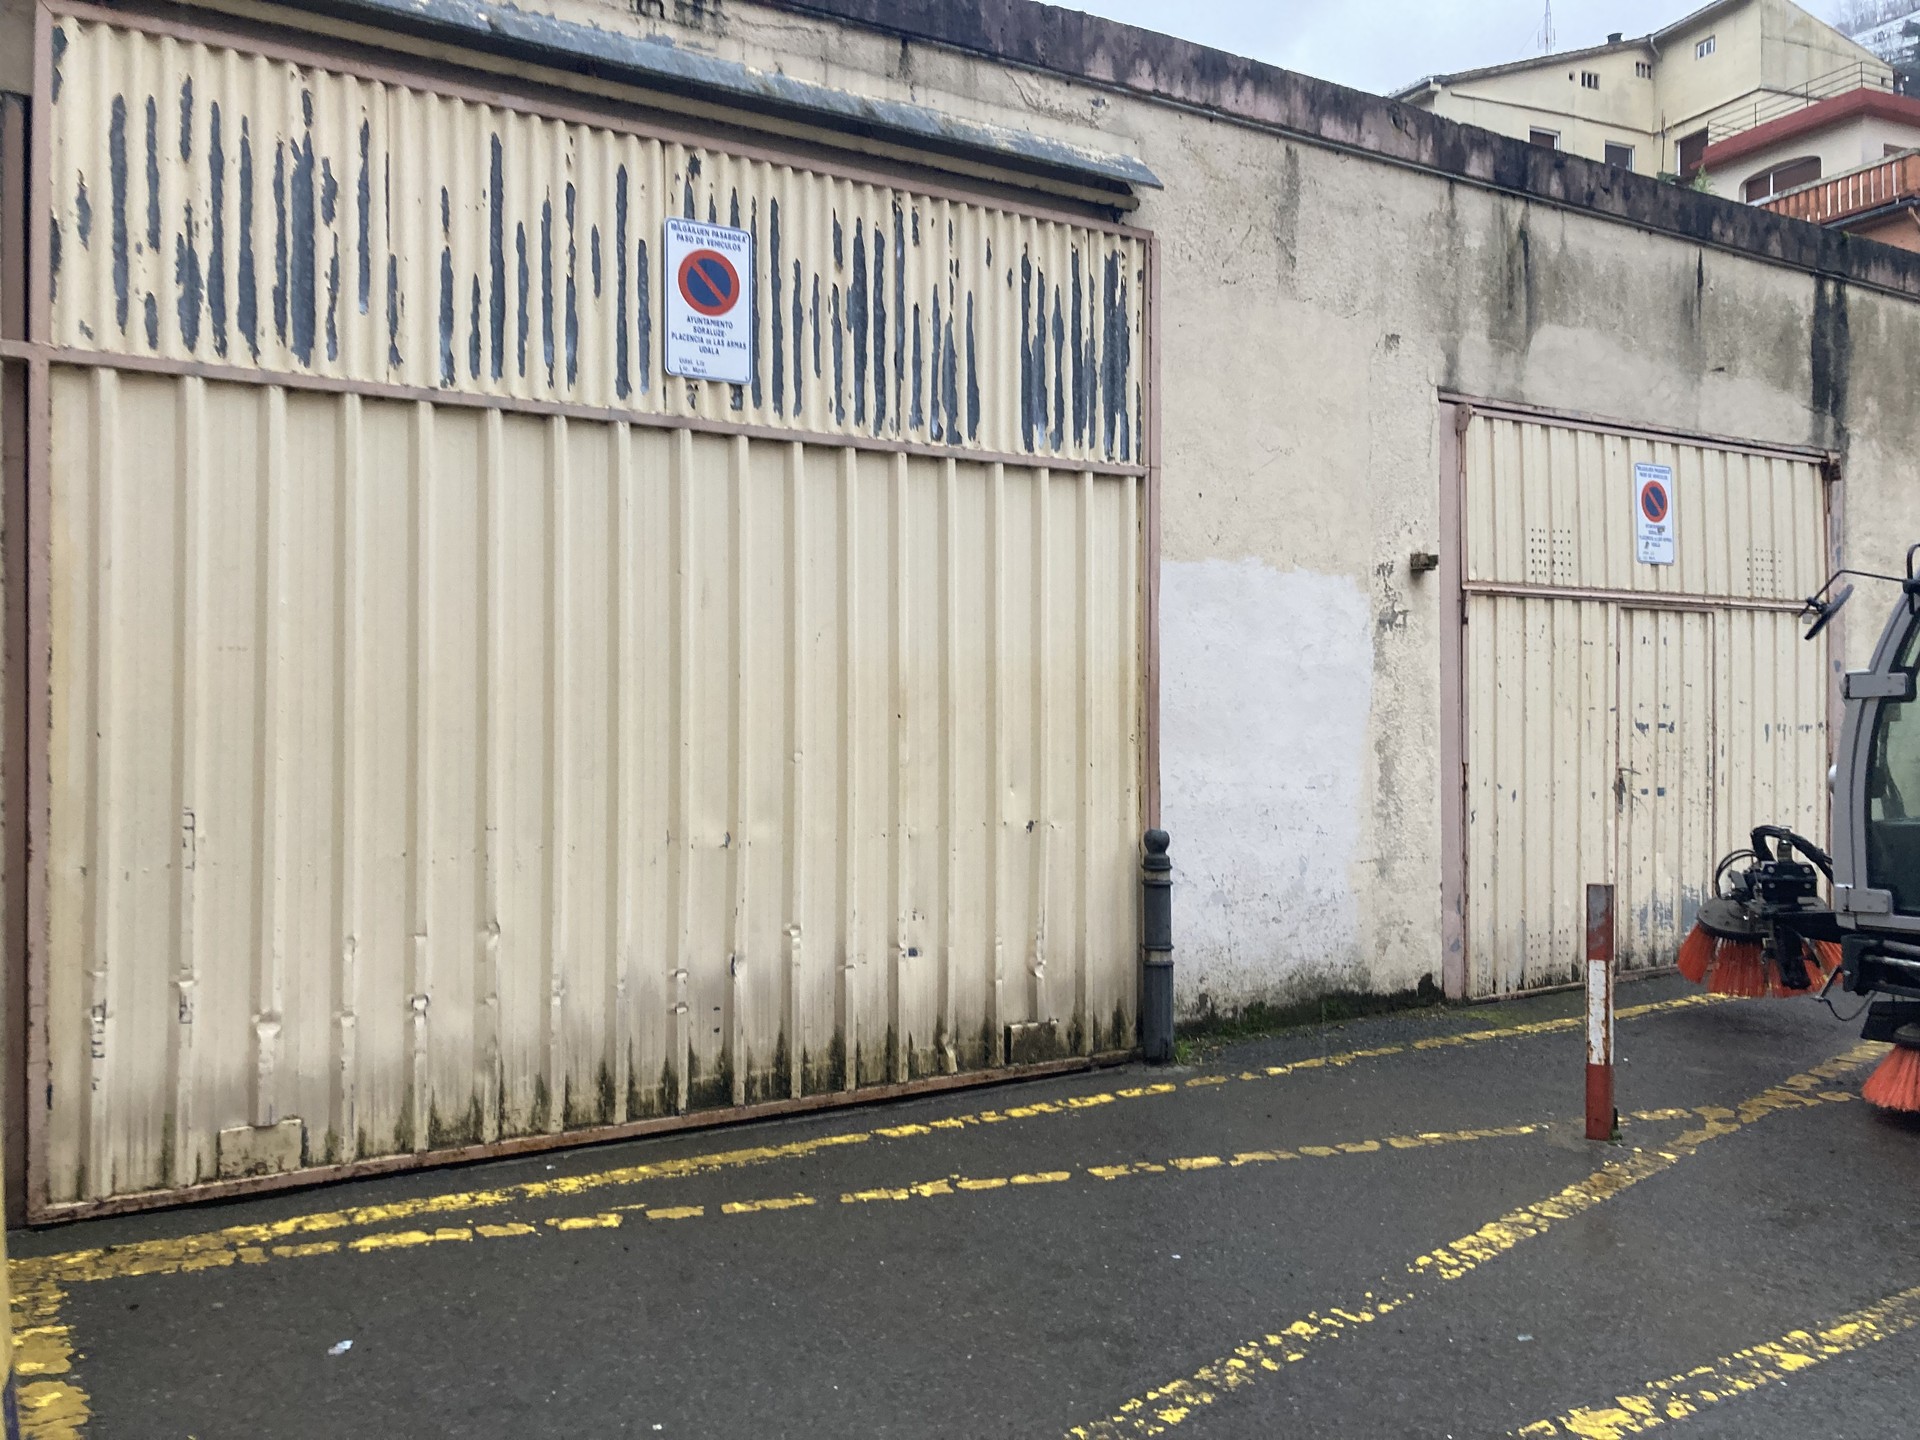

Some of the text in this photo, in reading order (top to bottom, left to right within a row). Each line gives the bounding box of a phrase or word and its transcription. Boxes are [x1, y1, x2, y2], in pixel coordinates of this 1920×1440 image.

[676, 233, 694, 243] PASO
[696, 236, 704, 245] DE
[687, 315, 733, 329] AYUNTAMIENTO
[671, 332, 704, 345] PLACENCIA
[713, 338, 725, 347] LAS
[727, 340, 747, 350] ARMAS
[699, 346, 720, 355] UDALA
